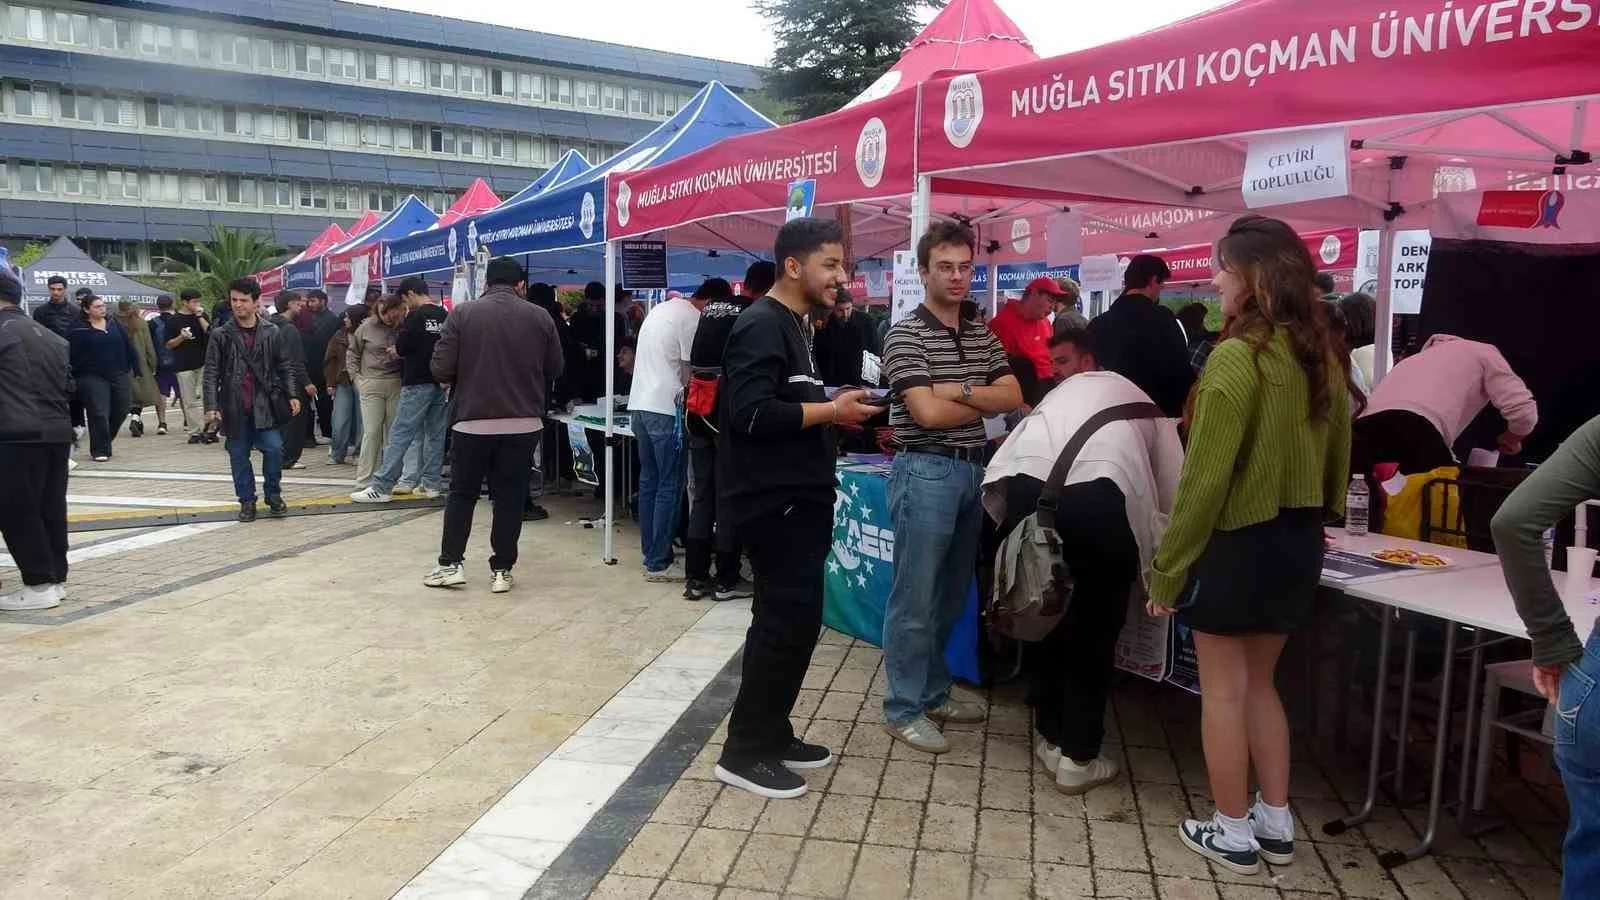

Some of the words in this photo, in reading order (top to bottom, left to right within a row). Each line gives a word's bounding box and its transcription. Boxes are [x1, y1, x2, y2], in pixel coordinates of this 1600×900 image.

[1011, 73, 1101, 118] MUĞLA
[1107, 57, 1186, 101] SITKI
[1195, 26, 1356, 88] KOÇMAN
[1370, 0, 1600, 58] ÜNİVERS
[1268, 145, 1316, 170] ÇEVİRİ
[637, 189, 667, 208] MUĞLA
[668, 177, 693, 202] SITKI
[694, 164, 744, 194] KOÇMAN
[743, 145, 838, 183] ÜNİVERSİTESİ
[1250, 165, 1336, 192] TOPLULUĞU
[1171, 257, 1194, 271] SITKI
[1401, 246, 1429, 257] DEN
[1396, 262, 1425, 273] ARK
